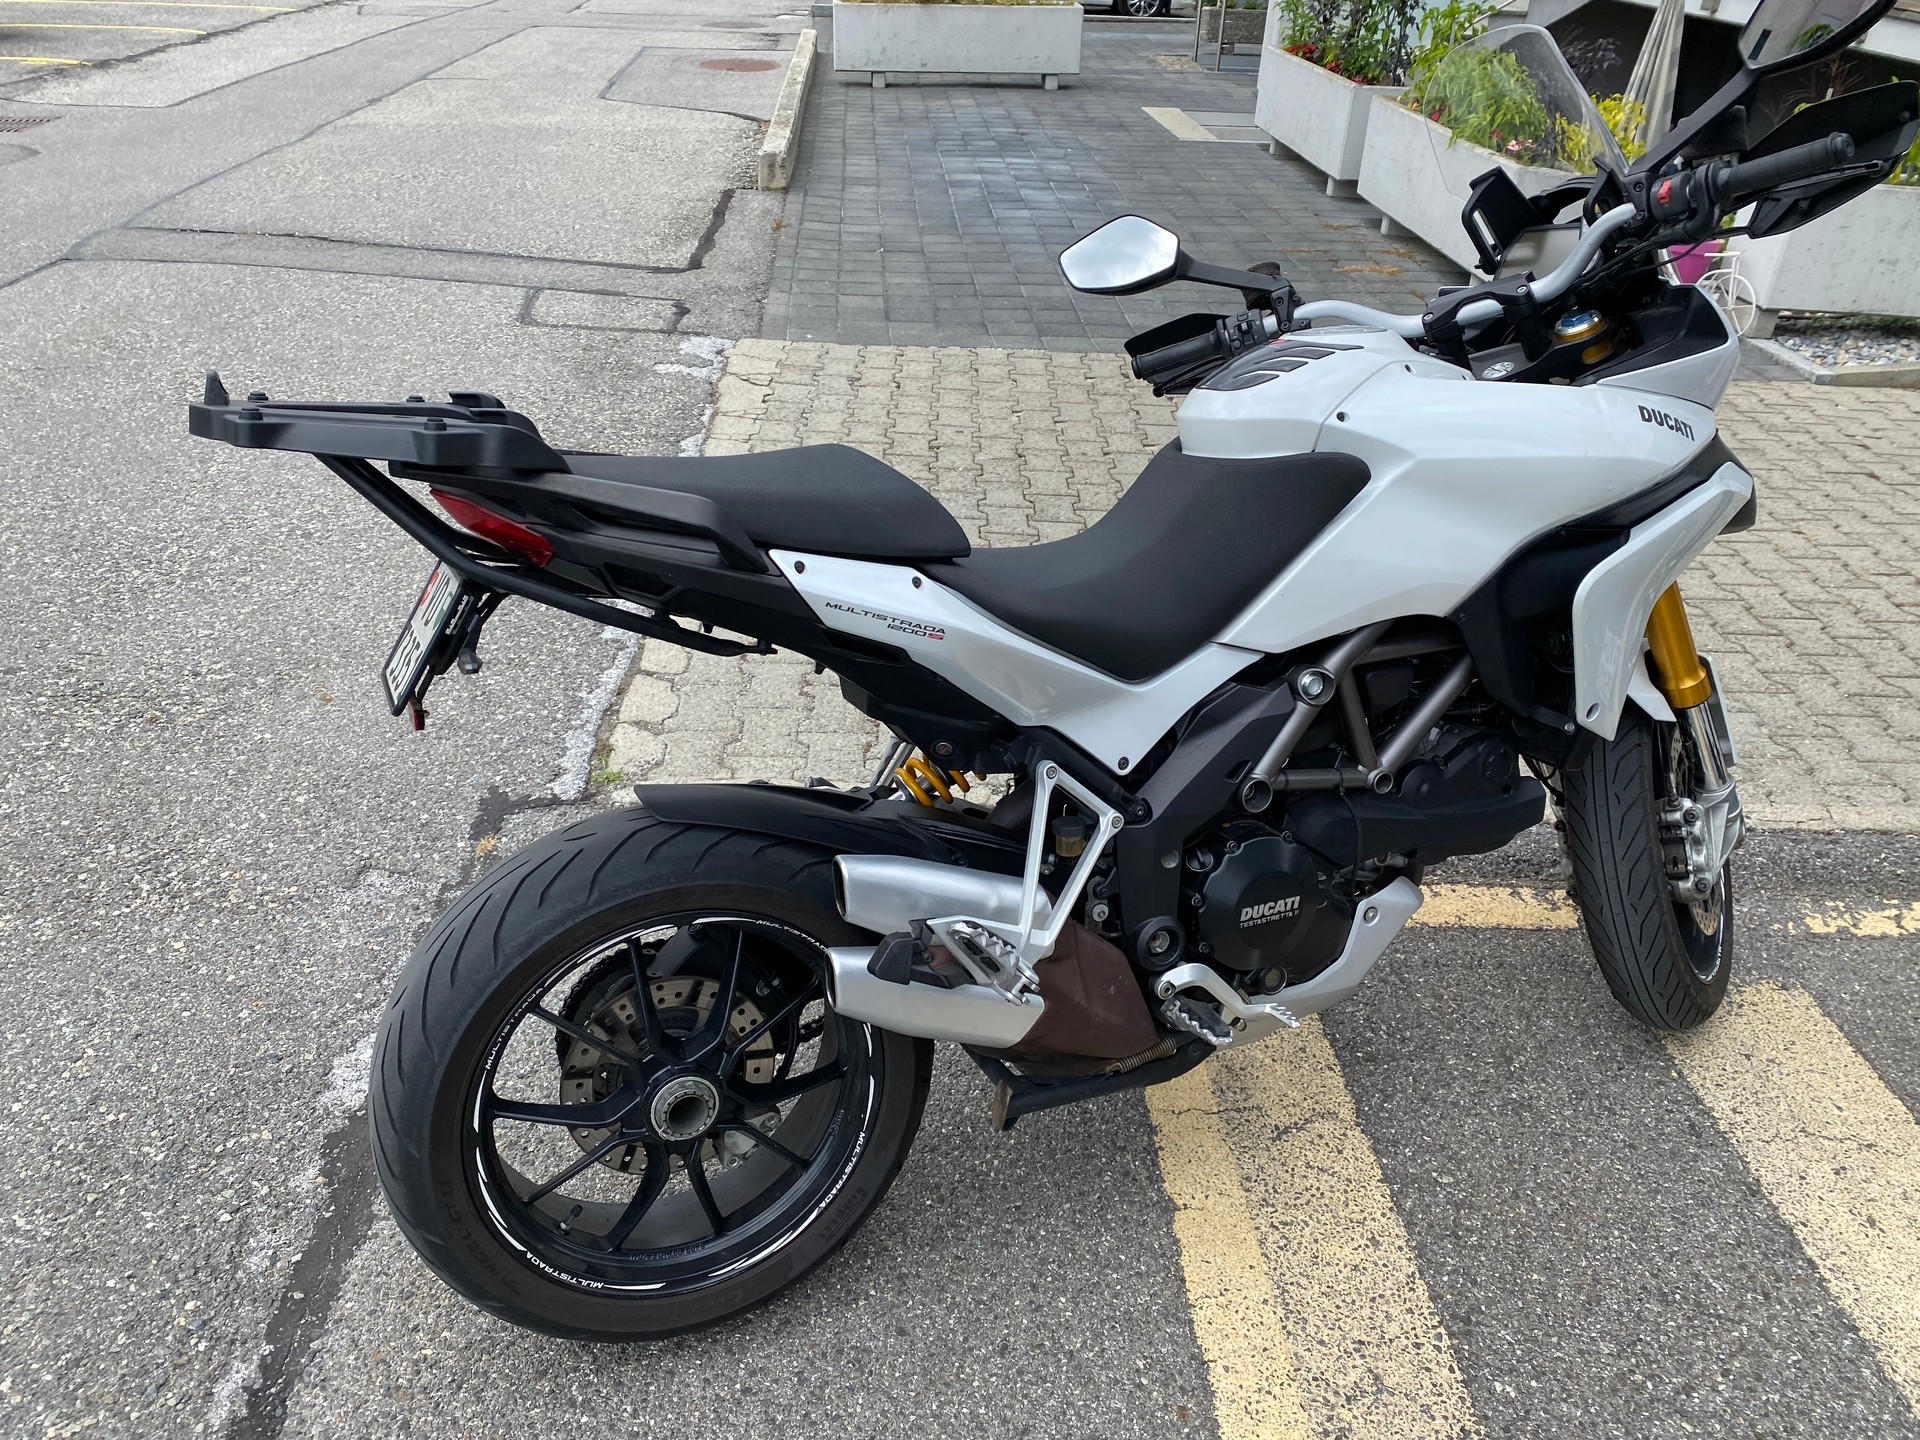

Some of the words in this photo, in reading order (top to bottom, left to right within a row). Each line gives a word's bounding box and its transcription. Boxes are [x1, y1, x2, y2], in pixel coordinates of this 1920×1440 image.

[1638, 404, 1695, 442] DUCATI
[825, 601, 946, 635] MULTISTRADA
[1239, 911, 1293, 929] TESTASTRETTA
[1240, 895, 1301, 922] DUCATI
[756, 919, 827, 952] MULTISTRAD
[484, 986, 544, 1070] MULTISTRADA
[818, 1130, 866, 1208] MULTISTRADA
[525, 1250, 604, 1289] MULTISTRADA
